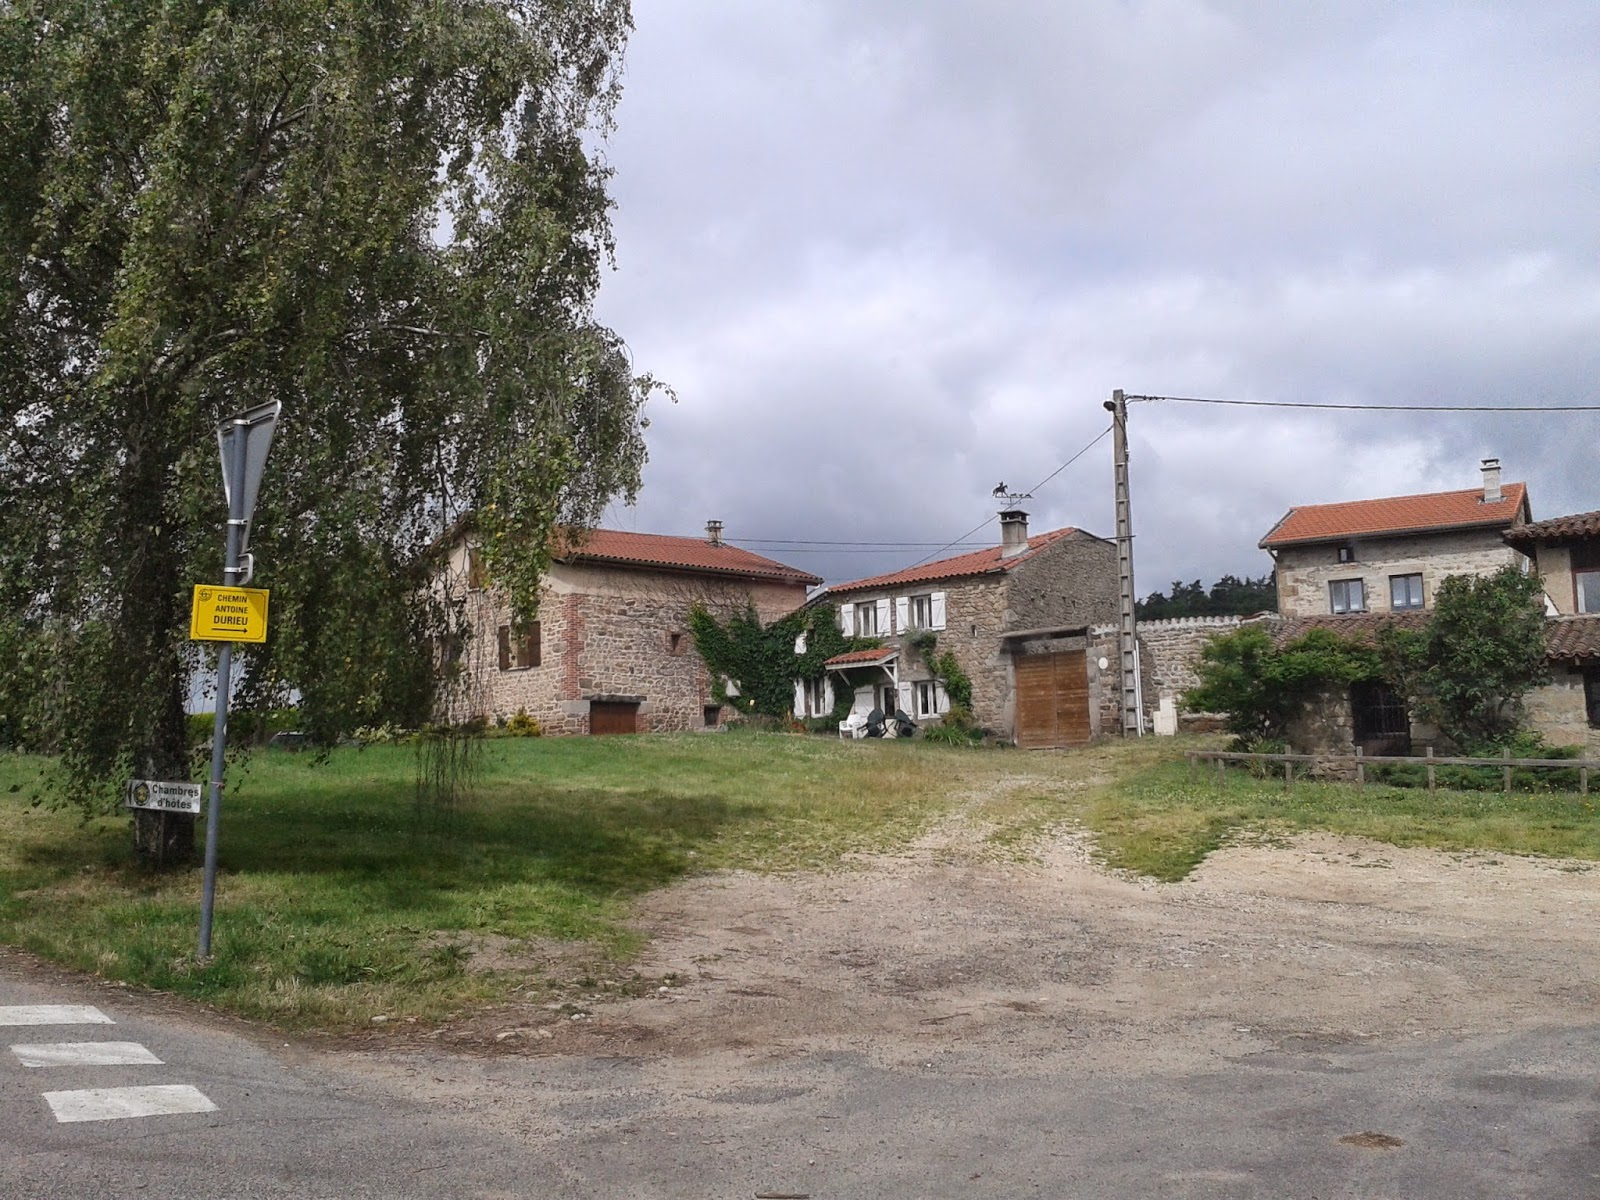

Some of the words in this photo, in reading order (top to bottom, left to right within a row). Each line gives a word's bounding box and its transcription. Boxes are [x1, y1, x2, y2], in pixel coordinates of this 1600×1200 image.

[217, 594, 248, 603] CHEMIN
[215, 605, 249, 614] ANTOINE
[213, 615, 248, 625] DURIEU
[152, 784, 199, 798] Chambres
[157, 798, 192, 809] d'hôtes
